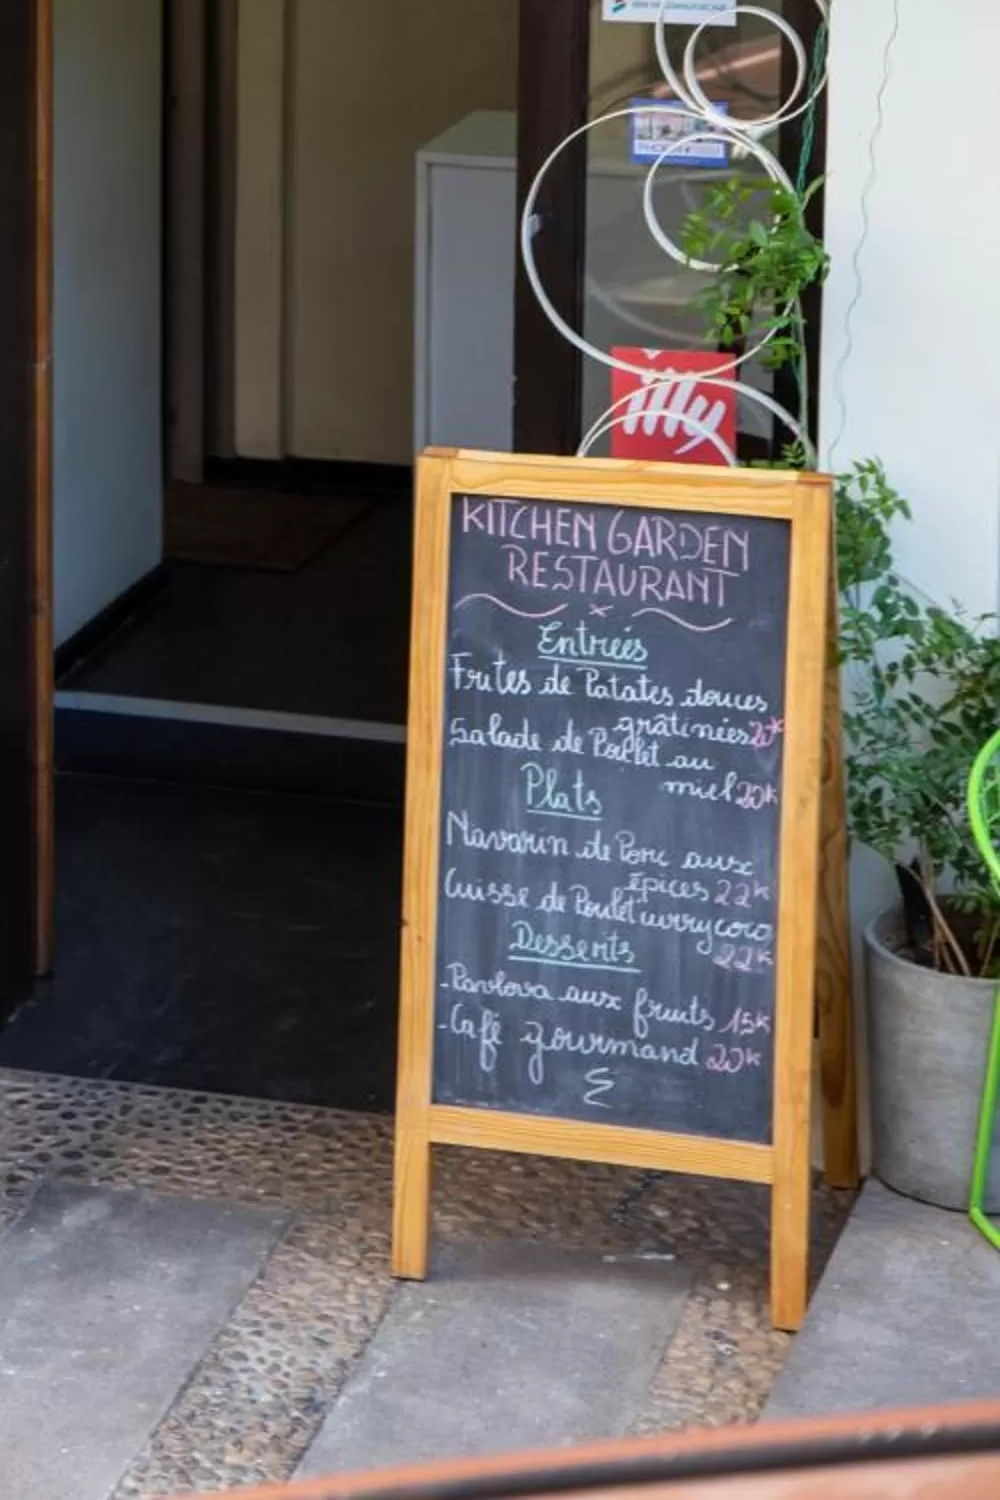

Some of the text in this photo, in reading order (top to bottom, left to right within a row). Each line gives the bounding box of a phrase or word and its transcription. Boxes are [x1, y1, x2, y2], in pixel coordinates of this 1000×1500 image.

[622, 366, 726, 455] illy
[462, 496, 749, 572] KITCHEN GARDEN
[501, 544, 740, 607] RESTAURANT
[537, 620, 649, 663] Entrées
[538, 663, 575, 696] de
[576, 666, 674, 707] Patates
[680, 678, 769, 713] douces
[450, 713, 716, 772] Salade de Poulet au
[520, 761, 603, 815] Plats
[662, 772, 738, 803] miel
[445, 810, 754, 876] Navarin de Porc aux
[444, 868, 530, 908] Cuisse
[535, 881, 567, 913] de
[568, 884, 636, 925] Poulet
[714, 918, 774, 942] coco
[508, 920, 635, 963] Desserts
[559, 984, 622, 1011] aux
[633, 988, 716, 1039] fruits
[520, 1020, 700, 1085] gourmand
